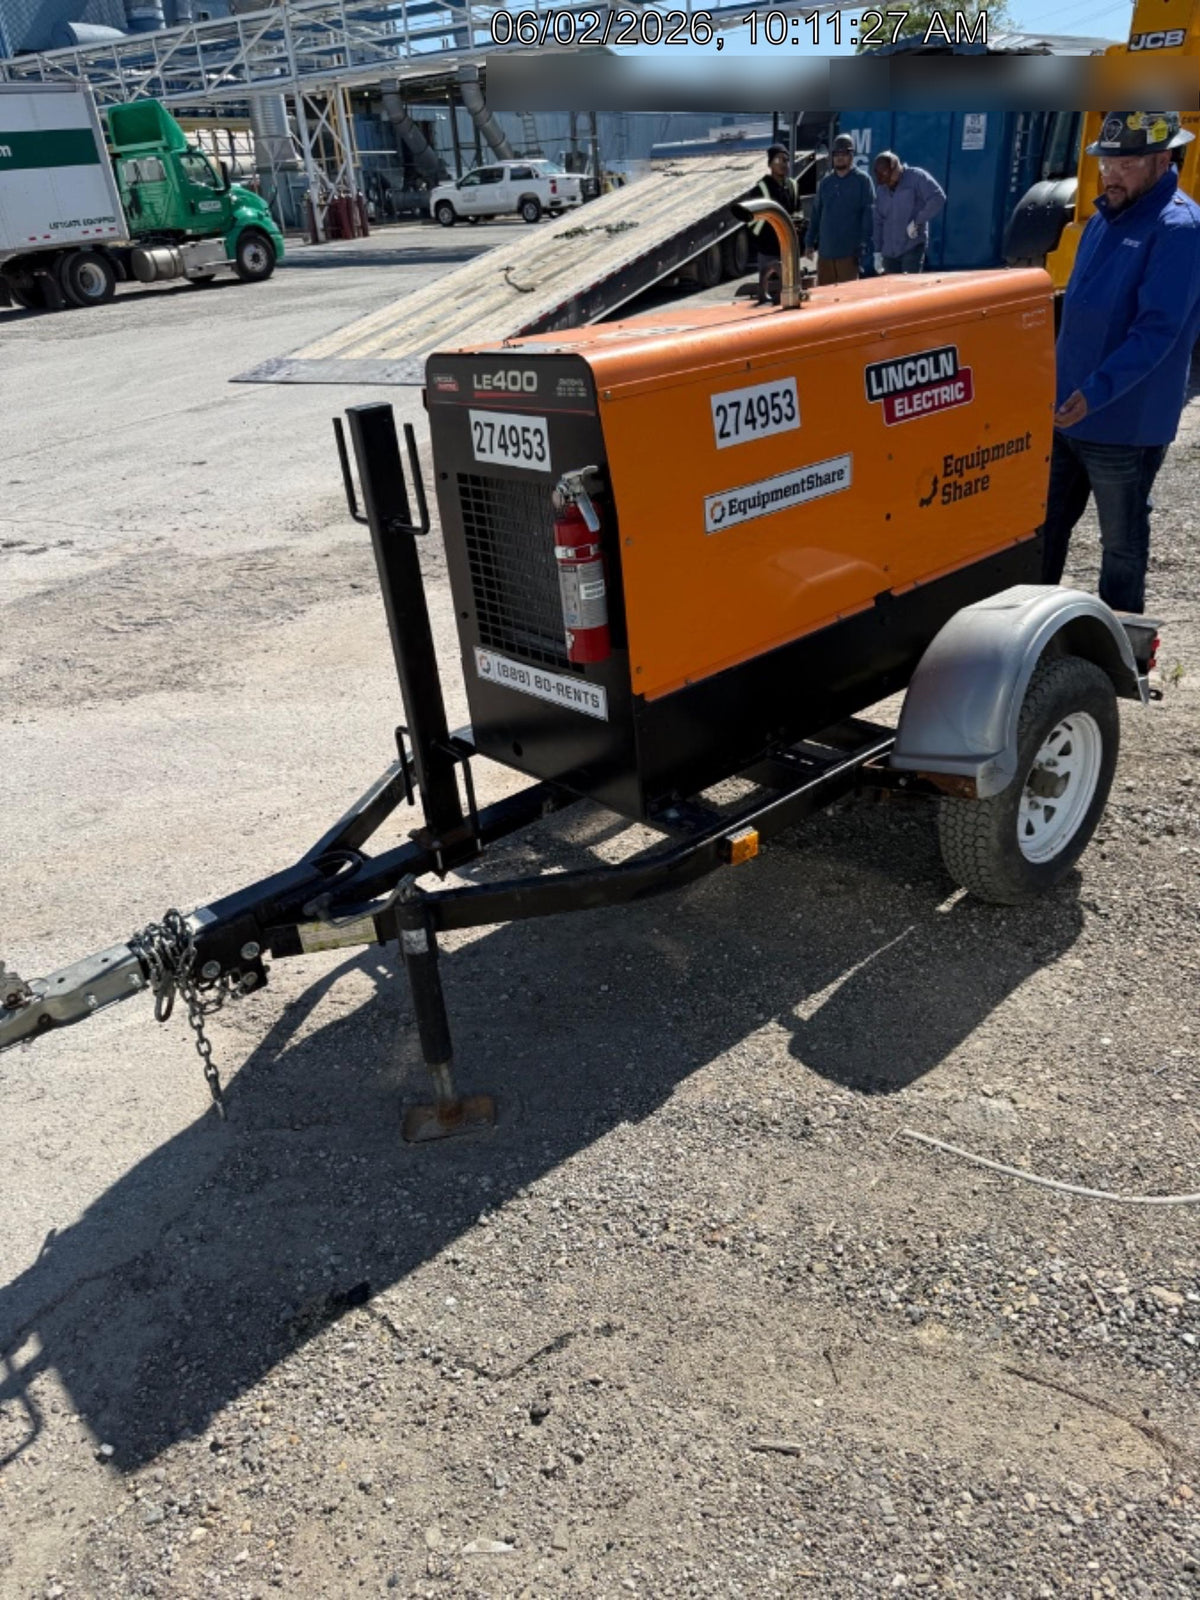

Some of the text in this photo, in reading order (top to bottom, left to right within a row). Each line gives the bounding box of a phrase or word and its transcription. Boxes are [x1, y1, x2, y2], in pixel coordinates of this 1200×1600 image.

[1130, 29, 1185, 51] JCB
[473, 370, 538, 392] LE400
[870, 351, 955, 397] LINCOLN
[714, 388, 796, 440] 274953
[894, 381, 965, 418] ELECTRIC
[473, 420, 546, 462] 274953
[942, 431, 1032, 478] Equipment
[728, 466, 845, 516] EquipmentShare
[941, 473, 990, 506] Share
[497, 661, 600, 708] (888) 80-RENTS
